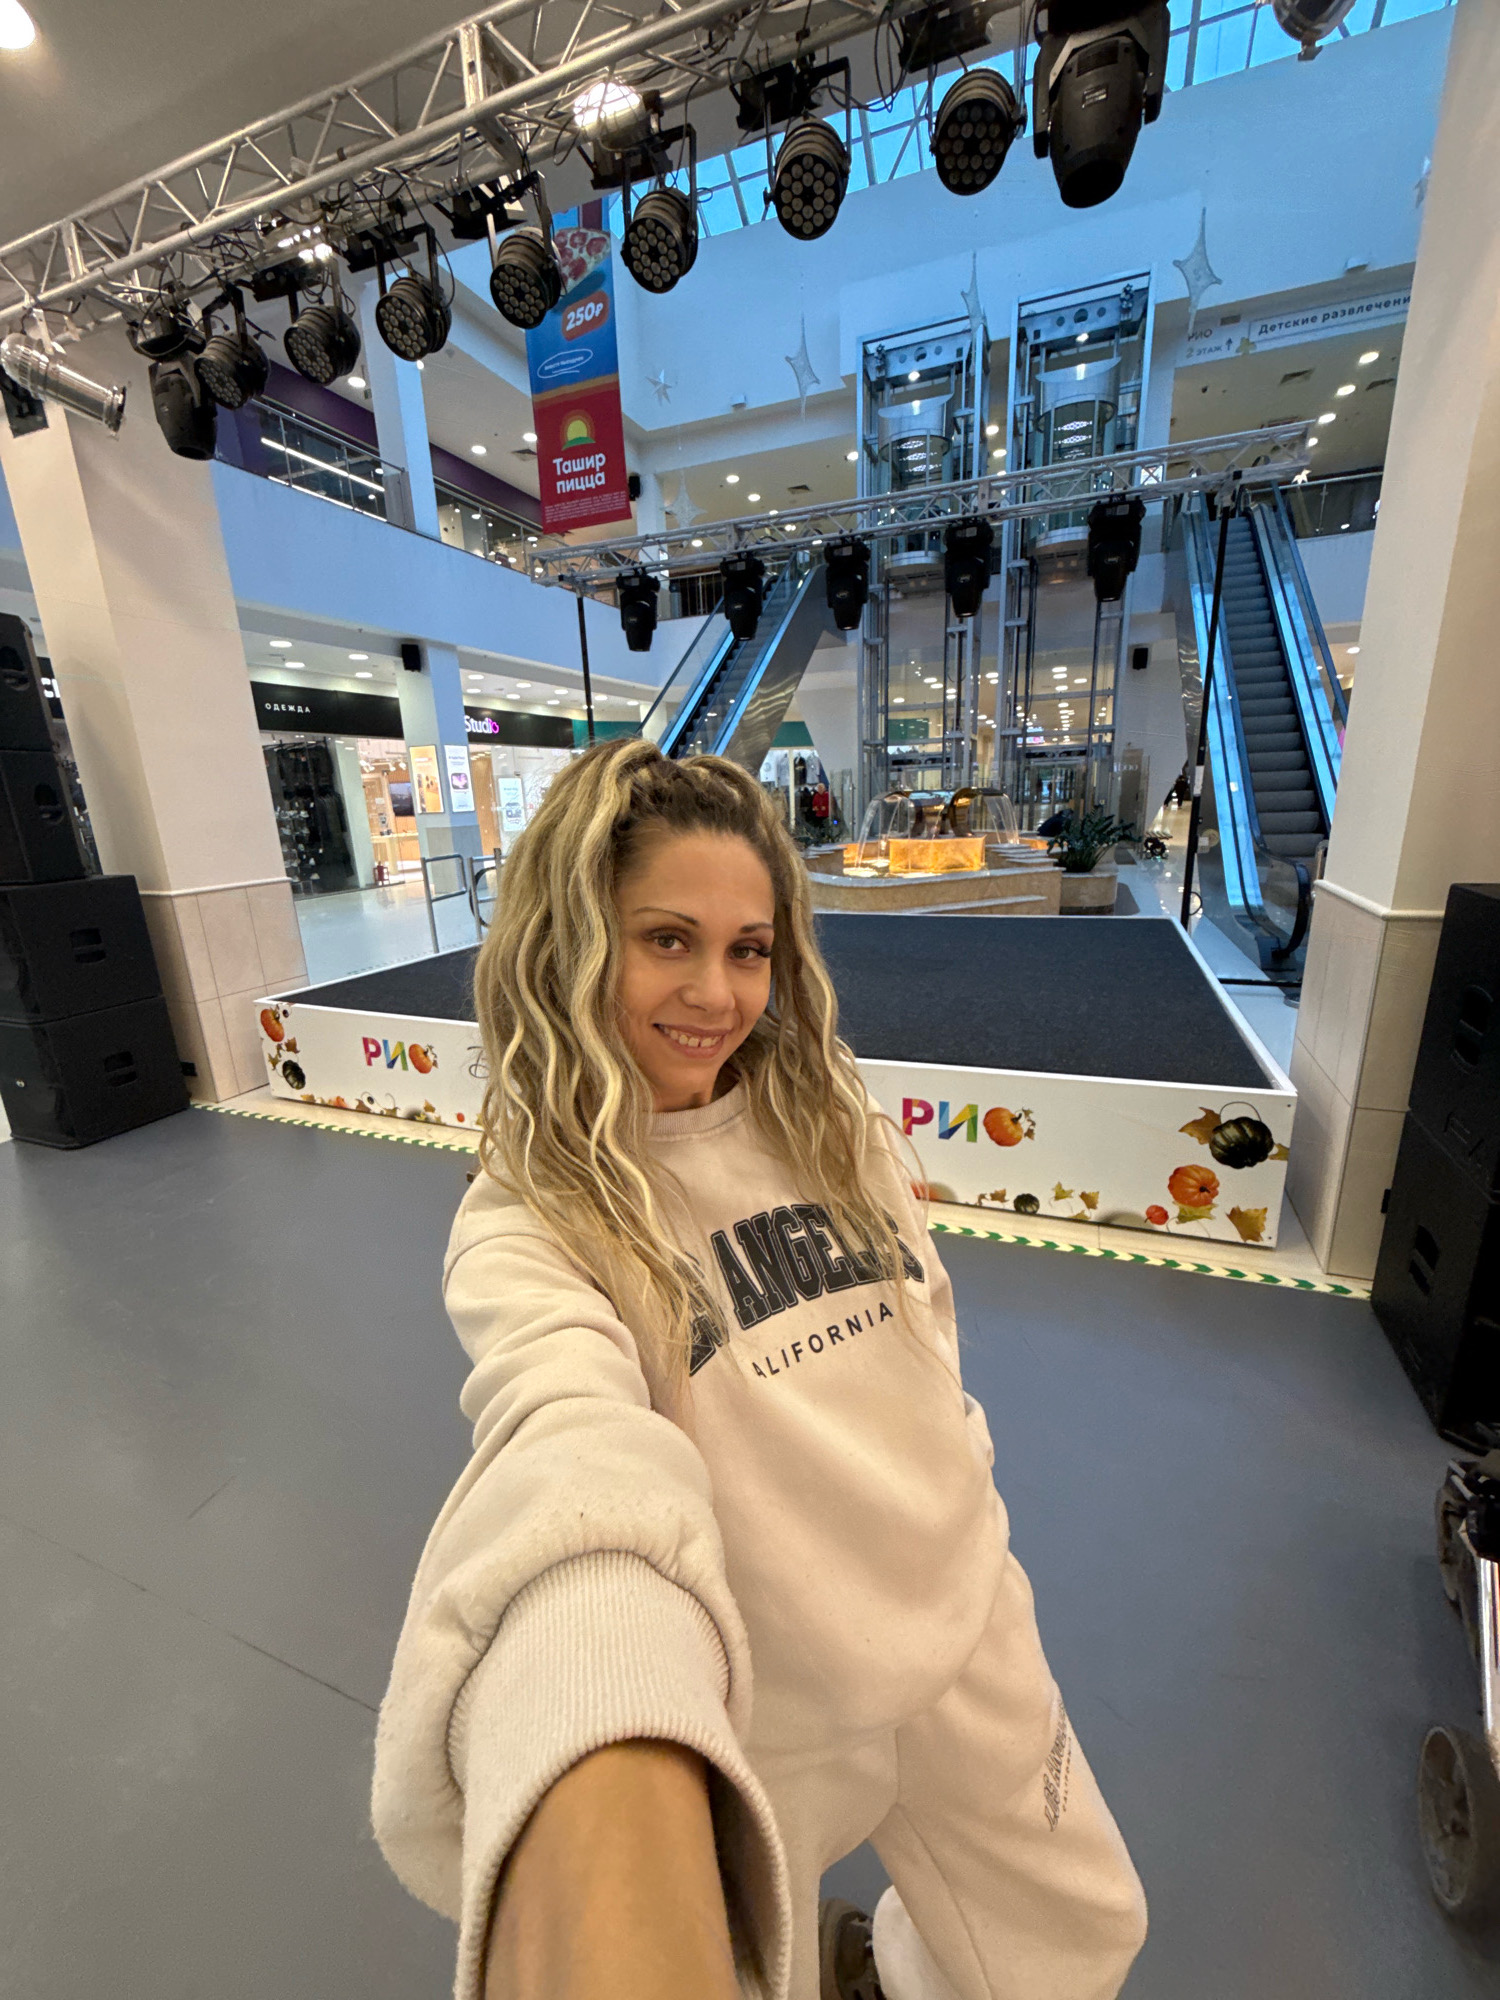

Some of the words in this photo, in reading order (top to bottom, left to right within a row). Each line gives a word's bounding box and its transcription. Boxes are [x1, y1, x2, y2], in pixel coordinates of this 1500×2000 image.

[1258, 317, 1318, 336] Детские
[552, 453, 606, 476] Ташир
[556, 471, 606, 495] пицца
[264, 702, 311, 714] ОДЕЖДА
[751, 1302, 894, 1379] ALIFORNIA
